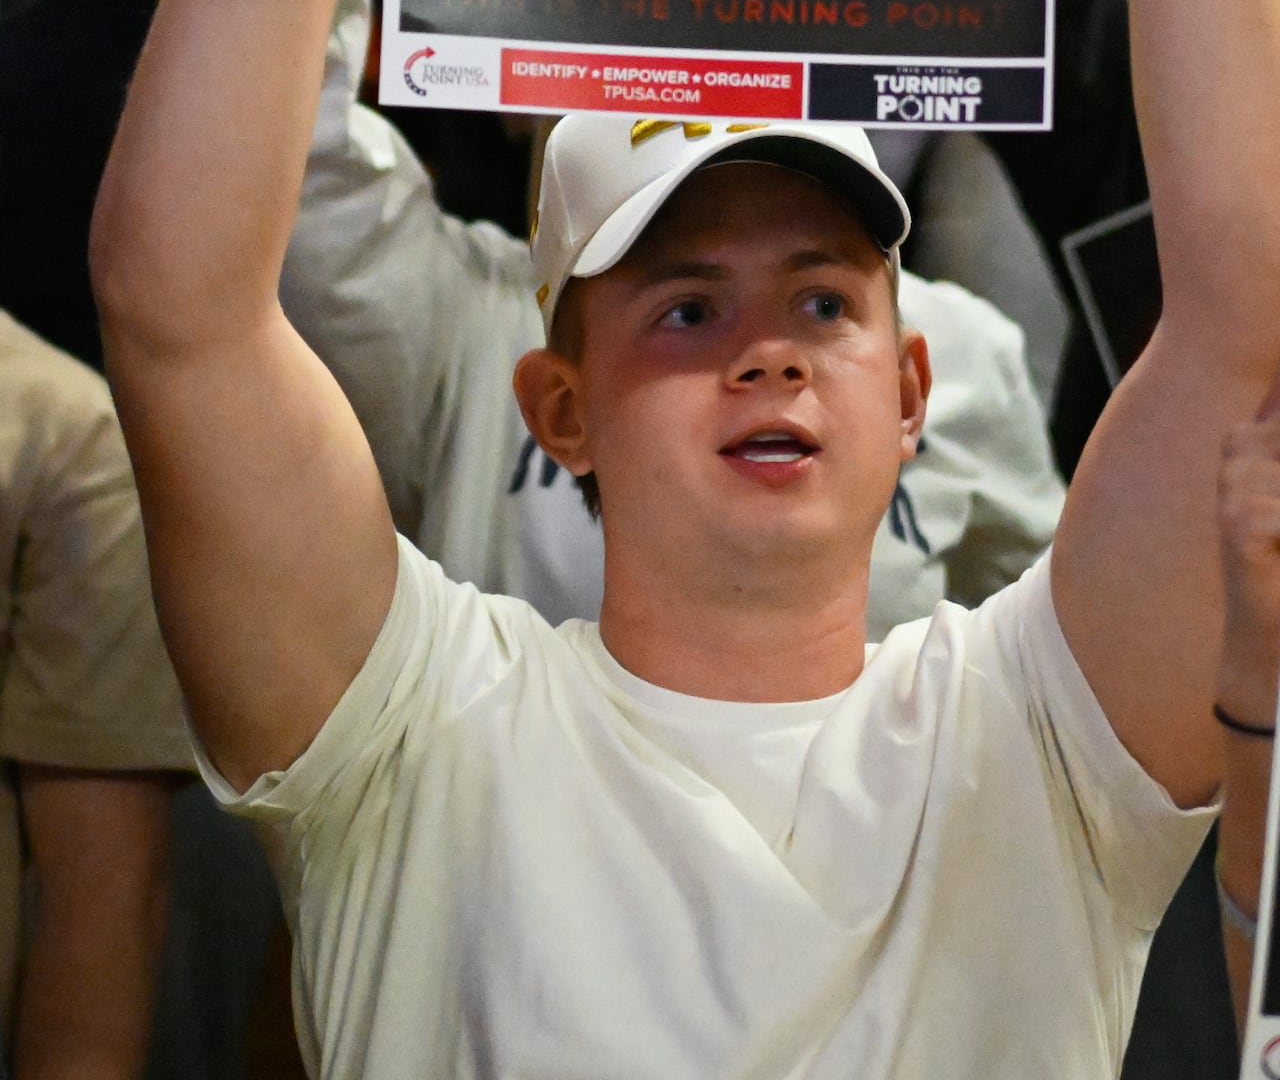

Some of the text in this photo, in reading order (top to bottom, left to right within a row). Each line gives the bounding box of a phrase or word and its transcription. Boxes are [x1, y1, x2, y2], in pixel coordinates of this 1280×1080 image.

[512, 62, 791, 89] IDENTIFY EMPOWER ORGANIZE
[873, 74, 983, 95] TURNING
[603, 85, 700, 103] TPUSA.COM
[877, 95, 983, 122] POINT
